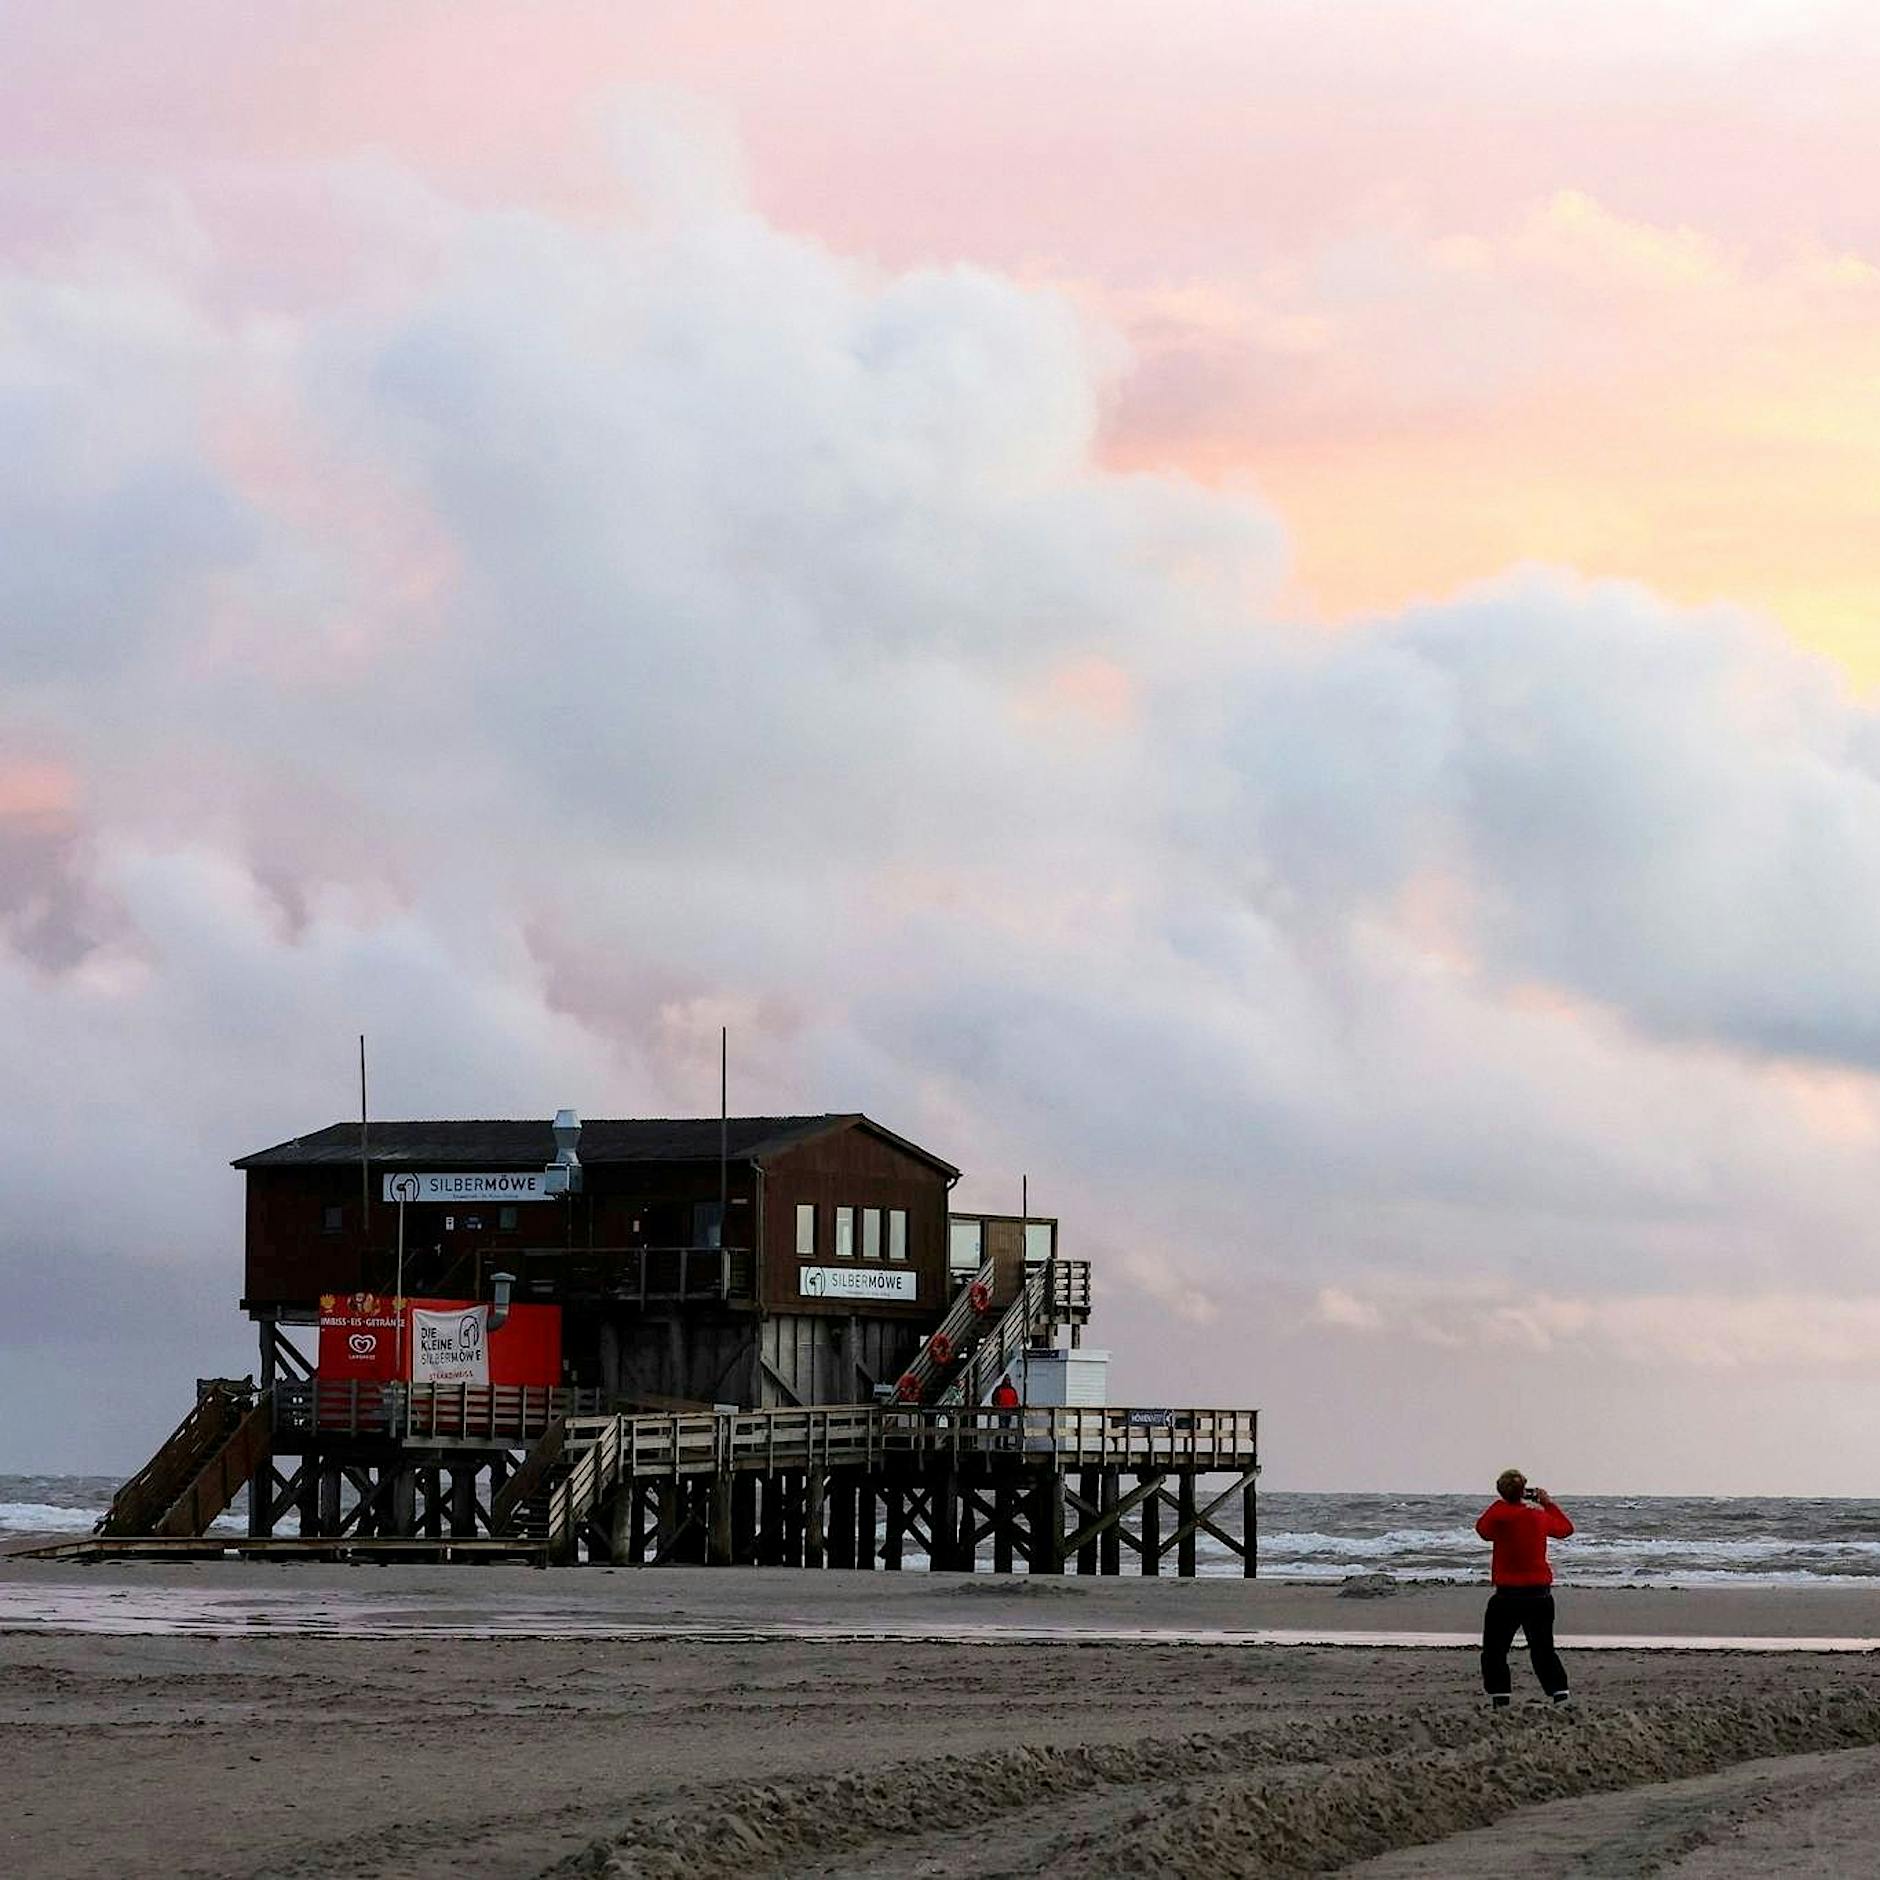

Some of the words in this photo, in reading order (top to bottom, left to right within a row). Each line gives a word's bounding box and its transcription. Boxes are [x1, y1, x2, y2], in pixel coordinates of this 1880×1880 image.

[430, 1174, 536, 1192] SILBERMÖWE
[831, 1272, 903, 1290] SILBERMÖWE
[350, 1317, 362, 1327] EIS
[421, 1327, 437, 1339] DIE
[421, 1339, 453, 1351] KLEINE
